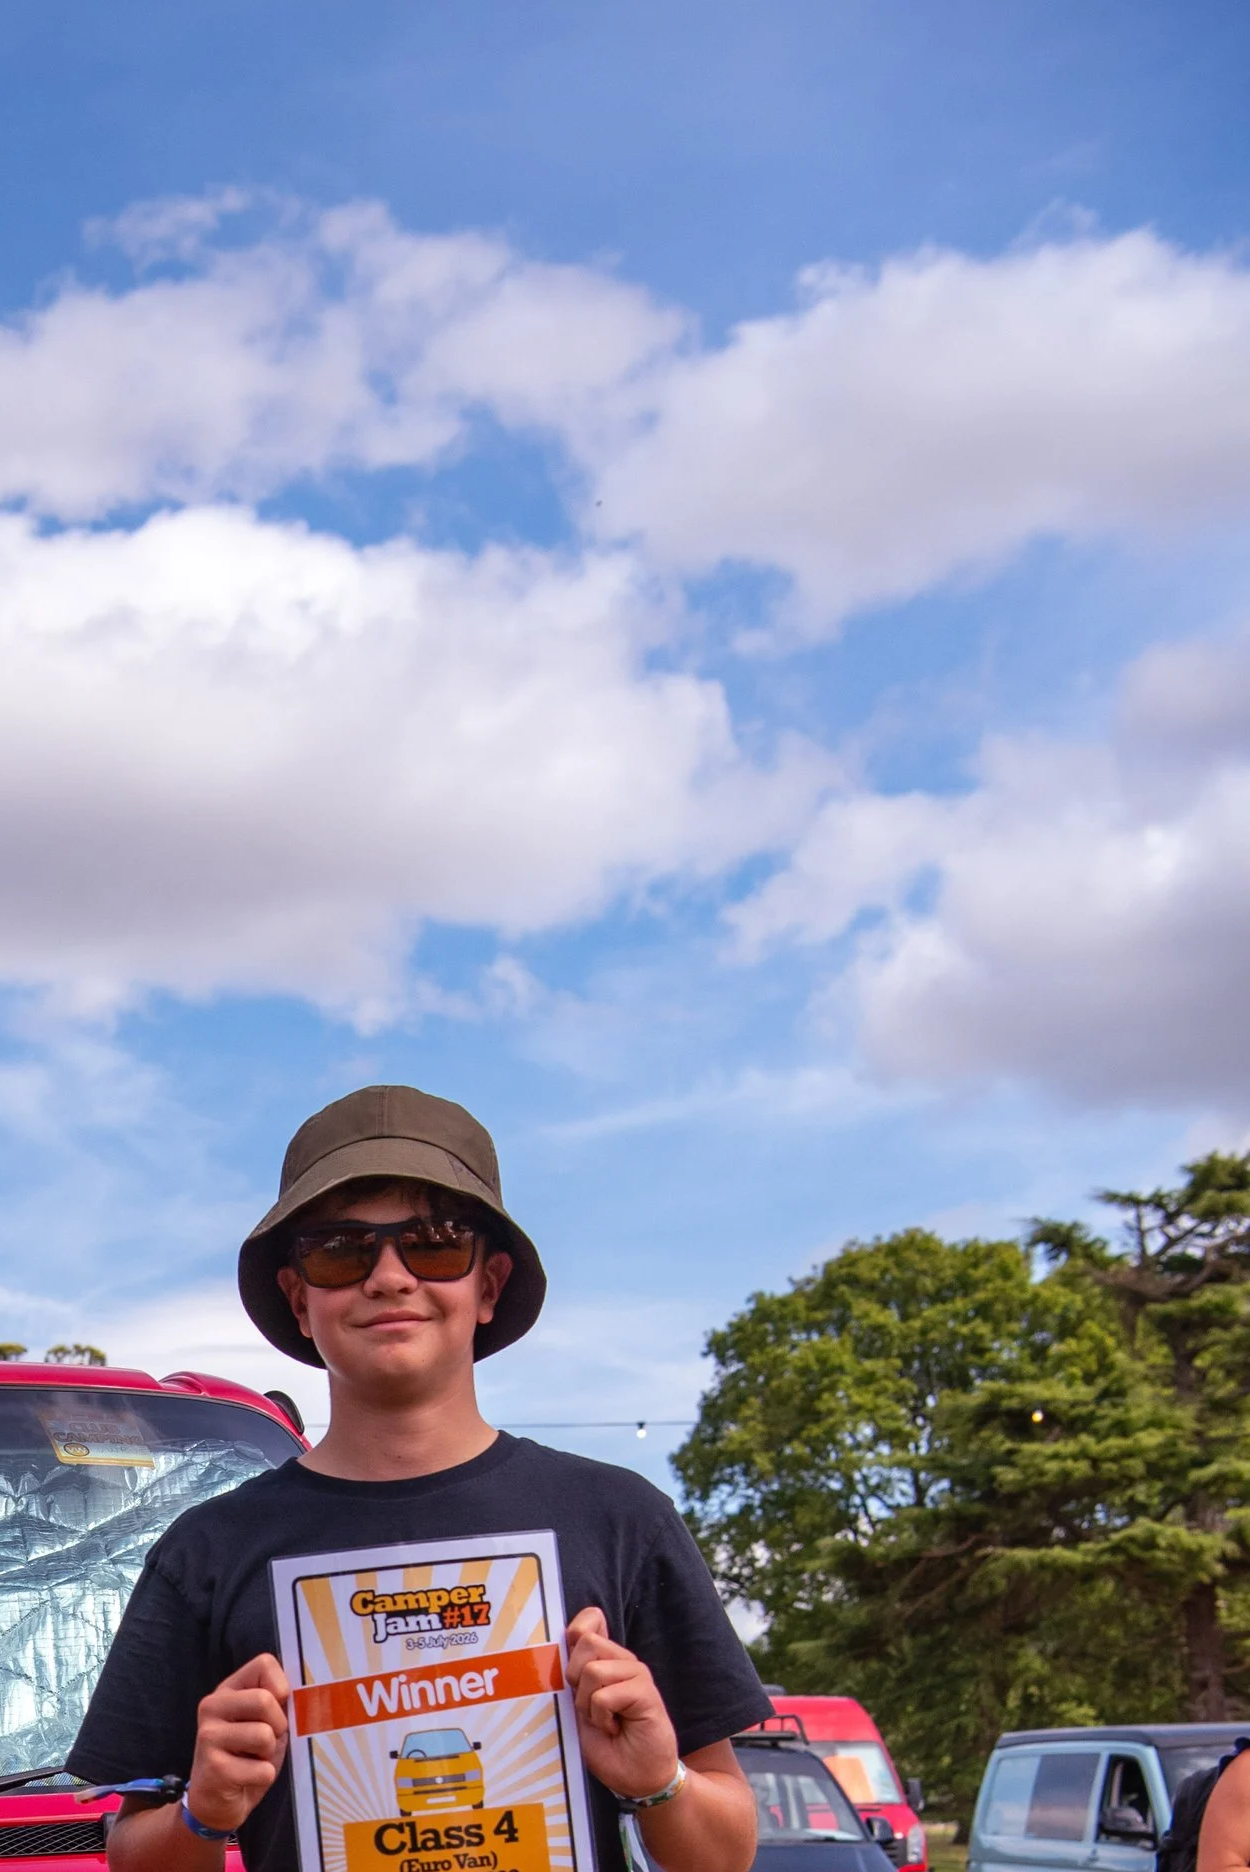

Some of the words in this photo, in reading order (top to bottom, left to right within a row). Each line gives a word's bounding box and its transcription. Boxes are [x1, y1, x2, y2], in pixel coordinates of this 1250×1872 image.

[350, 1584, 486, 1616] Camper
[406, 1637, 426, 1650] 3-5
[427, 1635, 450, 1649] July
[449, 1632, 478, 1645] 2026
[356, 1665, 499, 1718] Winner
[374, 1821, 485, 1856] Class
[493, 1810, 519, 1843] 4
[453, 1851, 498, 1870] Van)
